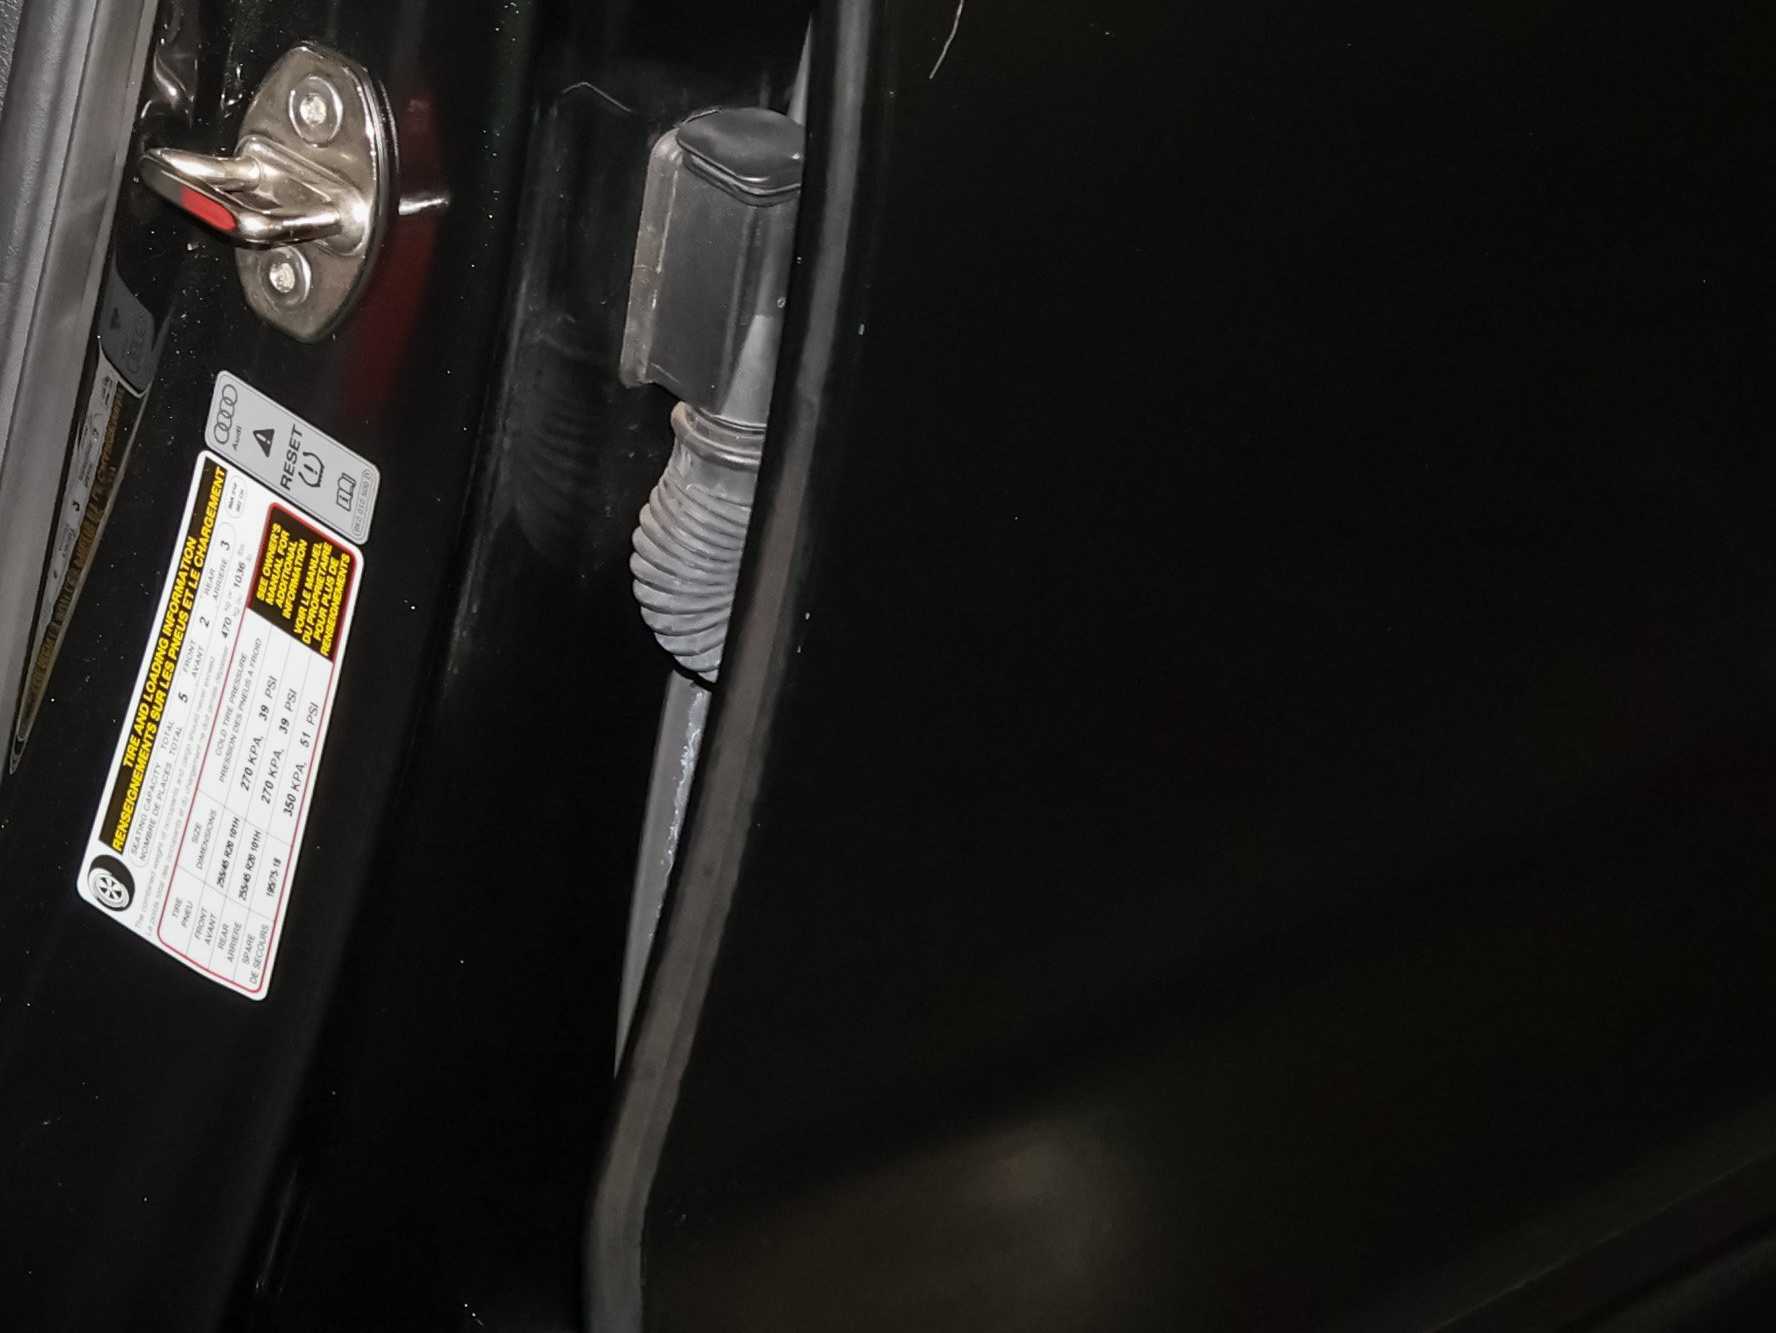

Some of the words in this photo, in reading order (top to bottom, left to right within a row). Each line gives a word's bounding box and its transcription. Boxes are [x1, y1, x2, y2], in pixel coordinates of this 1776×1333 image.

[231, 423, 242, 452] Audi
[279, 422, 303, 492] RESET
[189, 465, 228, 569] CHARGEMENT
[219, 538, 231, 552] 3
[260, 520, 282, 578] OWNER'S
[186, 567, 201, 589] LE
[264, 554, 284, 606] MANUAL
[276, 528, 290, 556] FOR
[274, 537, 298, 608] ADDITIONAL
[281, 537, 309, 620] INFORMATION
[303, 538, 323, 590] MANUEL
[327, 555, 339, 576] DE
[203, 567, 216, 596] REAR
[255, 575, 269, 602] SEE
[300, 587, 311, 606] LE
[320, 573, 335, 607] PLUS
[181, 587, 195, 611] ET
[219, 614, 233, 640] 470
[232, 559, 246, 589] 1036
[319, 551, 351, 657] RENSEIGNEMENTS
[167, 608, 189, 661] PNEUS
[198, 614, 210, 628] 2
[292, 603, 307, 636] VOIR
[301, 623, 314, 645] DU
[312, 604, 328, 642] POUR
[121, 732, 141, 771] TIRE
[132, 700, 150, 736] AND
[142, 634, 170, 703] LOADING
[161, 534, 198, 638] INFORMATION
[182, 637, 197, 674] FRONT
[190, 643, 205, 679] AVANT
[158, 658, 175, 690] LES
[263, 673, 277, 700] PSI
[149, 687, 167, 723] SUR
[176, 690, 189, 704] 5
[214, 727, 228, 758] COLD
[222, 704, 234, 728] TIRE
[228, 650, 248, 705] PRESSURE
[218, 732, 237, 784] PRESSION
[231, 711, 243, 734] DES
[237, 676, 252, 712] PNEUS
[248, 635, 262, 669] FROID
[257, 702, 270, 722] 39
[283, 686, 298, 713] PSI
[160, 717, 175, 751] TOTAL
[168, 723, 183, 757] TOTAL
[278, 715, 290, 735] 39
[299, 730, 311, 748] 51
[305, 699, 319, 726] PSI
[246, 730, 264, 767] KPA,
[111, 719, 158, 853] RENSEIGNEMENTS
[239, 764, 254, 792] 270
[260, 778, 274, 805] 270
[267, 743, 285, 780] KPA,
[289, 756, 307, 793] KPA,
[130, 812, 148, 856] SEATING
[142, 760, 162, 813] CAPACITY
[139, 817, 157, 862] NOMBRE
[151, 801, 161, 817] DE
[156, 760, 172, 802] PLACES
[282, 791, 297, 818] 350
[191, 820, 202, 844] SIZE
[196, 807, 218, 871] DIMENSIONS
[228, 815, 240, 840] 101H
[223, 838, 234, 859] R20
[237, 871, 252, 901] 255/45
[249, 828, 262, 853] 101H
[215, 857, 230, 889] 255/45
[171, 895, 183, 920] TIRE
[181, 899, 194, 929] PNEU
[194, 905, 208, 941] FRONT
[203, 912, 218, 946] AVANT
[217, 921, 230, 951] REAR
[251, 921, 270, 971] SECOURS
[241, 931, 255, 966] SPARE
[248, 968, 259, 985] DE
